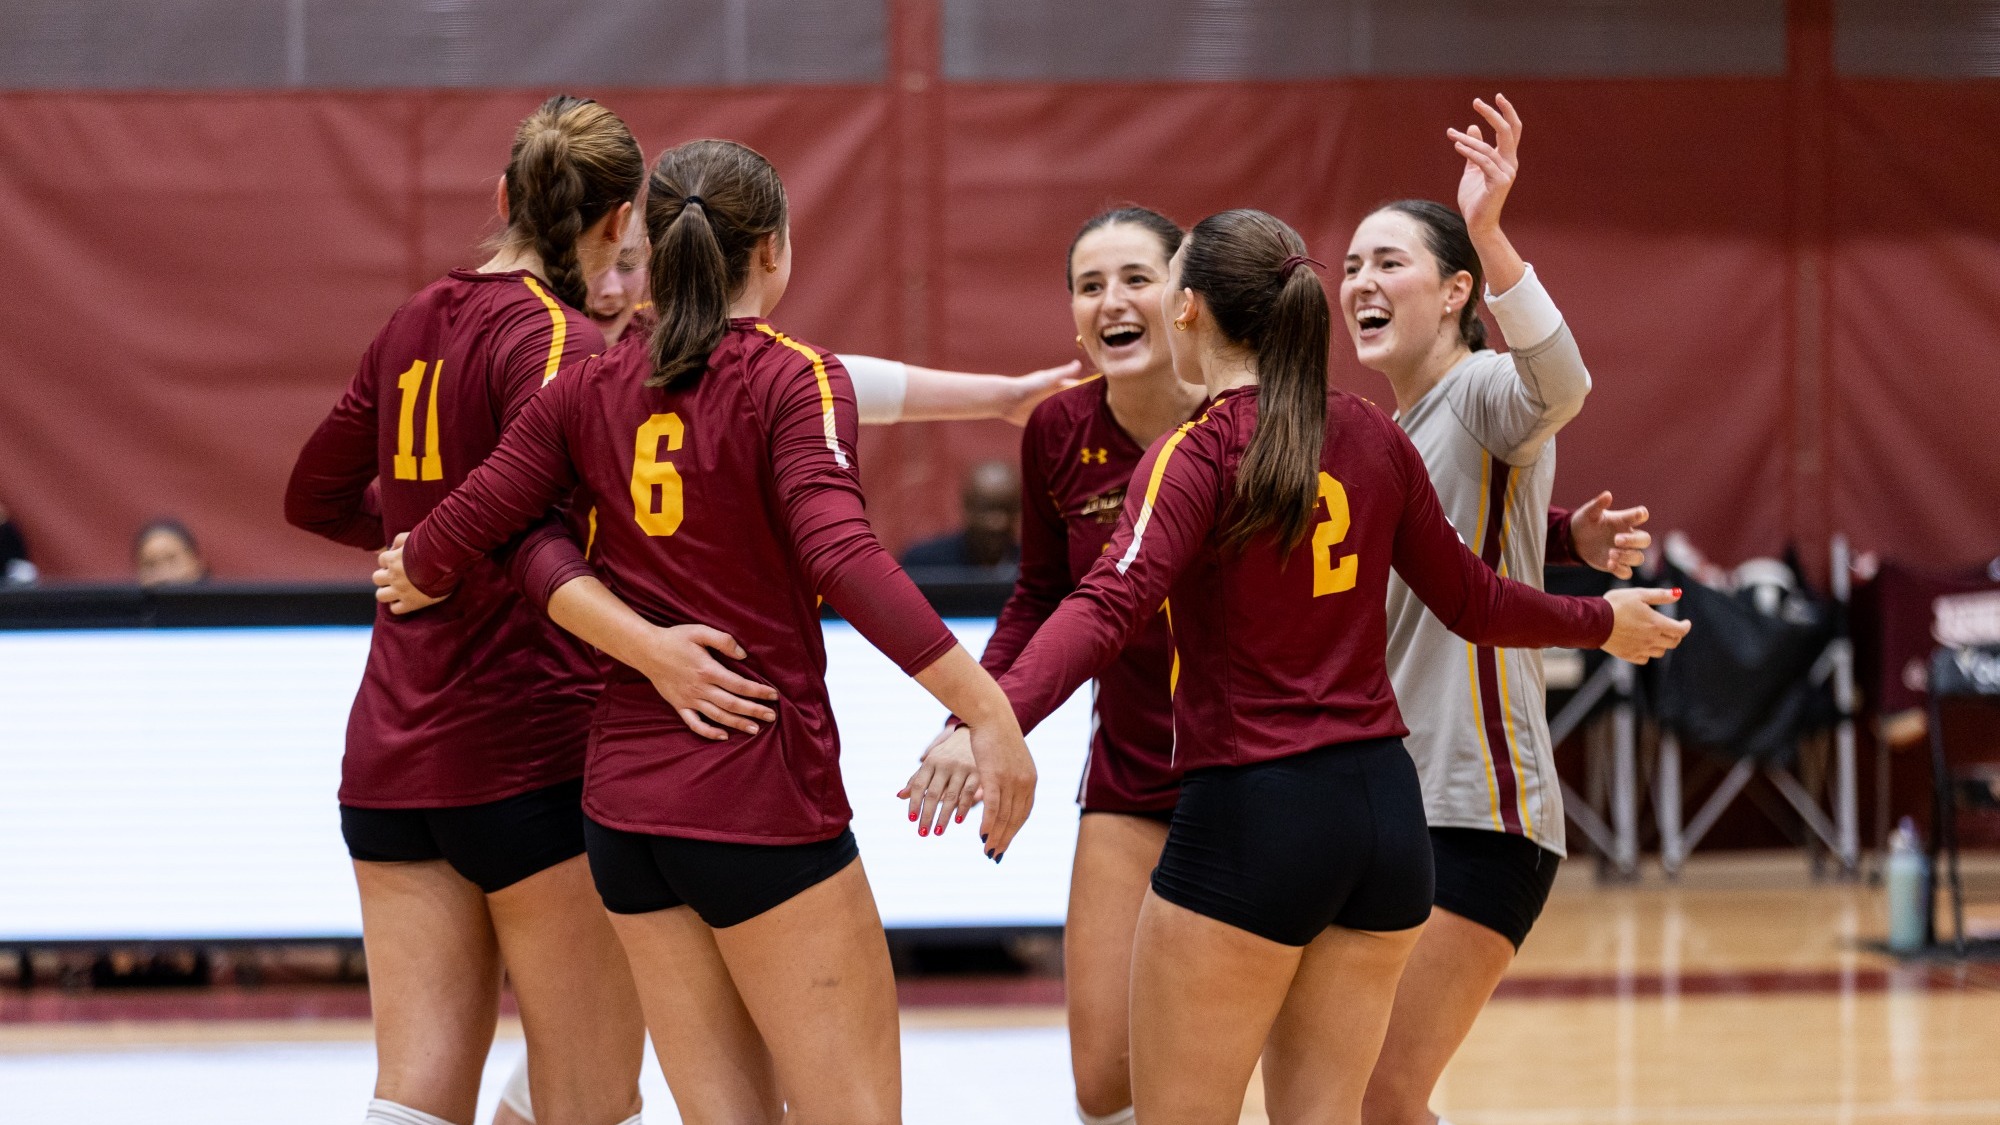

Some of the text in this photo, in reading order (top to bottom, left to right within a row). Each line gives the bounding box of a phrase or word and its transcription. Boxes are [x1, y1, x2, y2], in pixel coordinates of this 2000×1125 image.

[393, 359, 444, 481] 11
[630, 412, 685, 537] 6
[1311, 471, 1359, 598] 2
